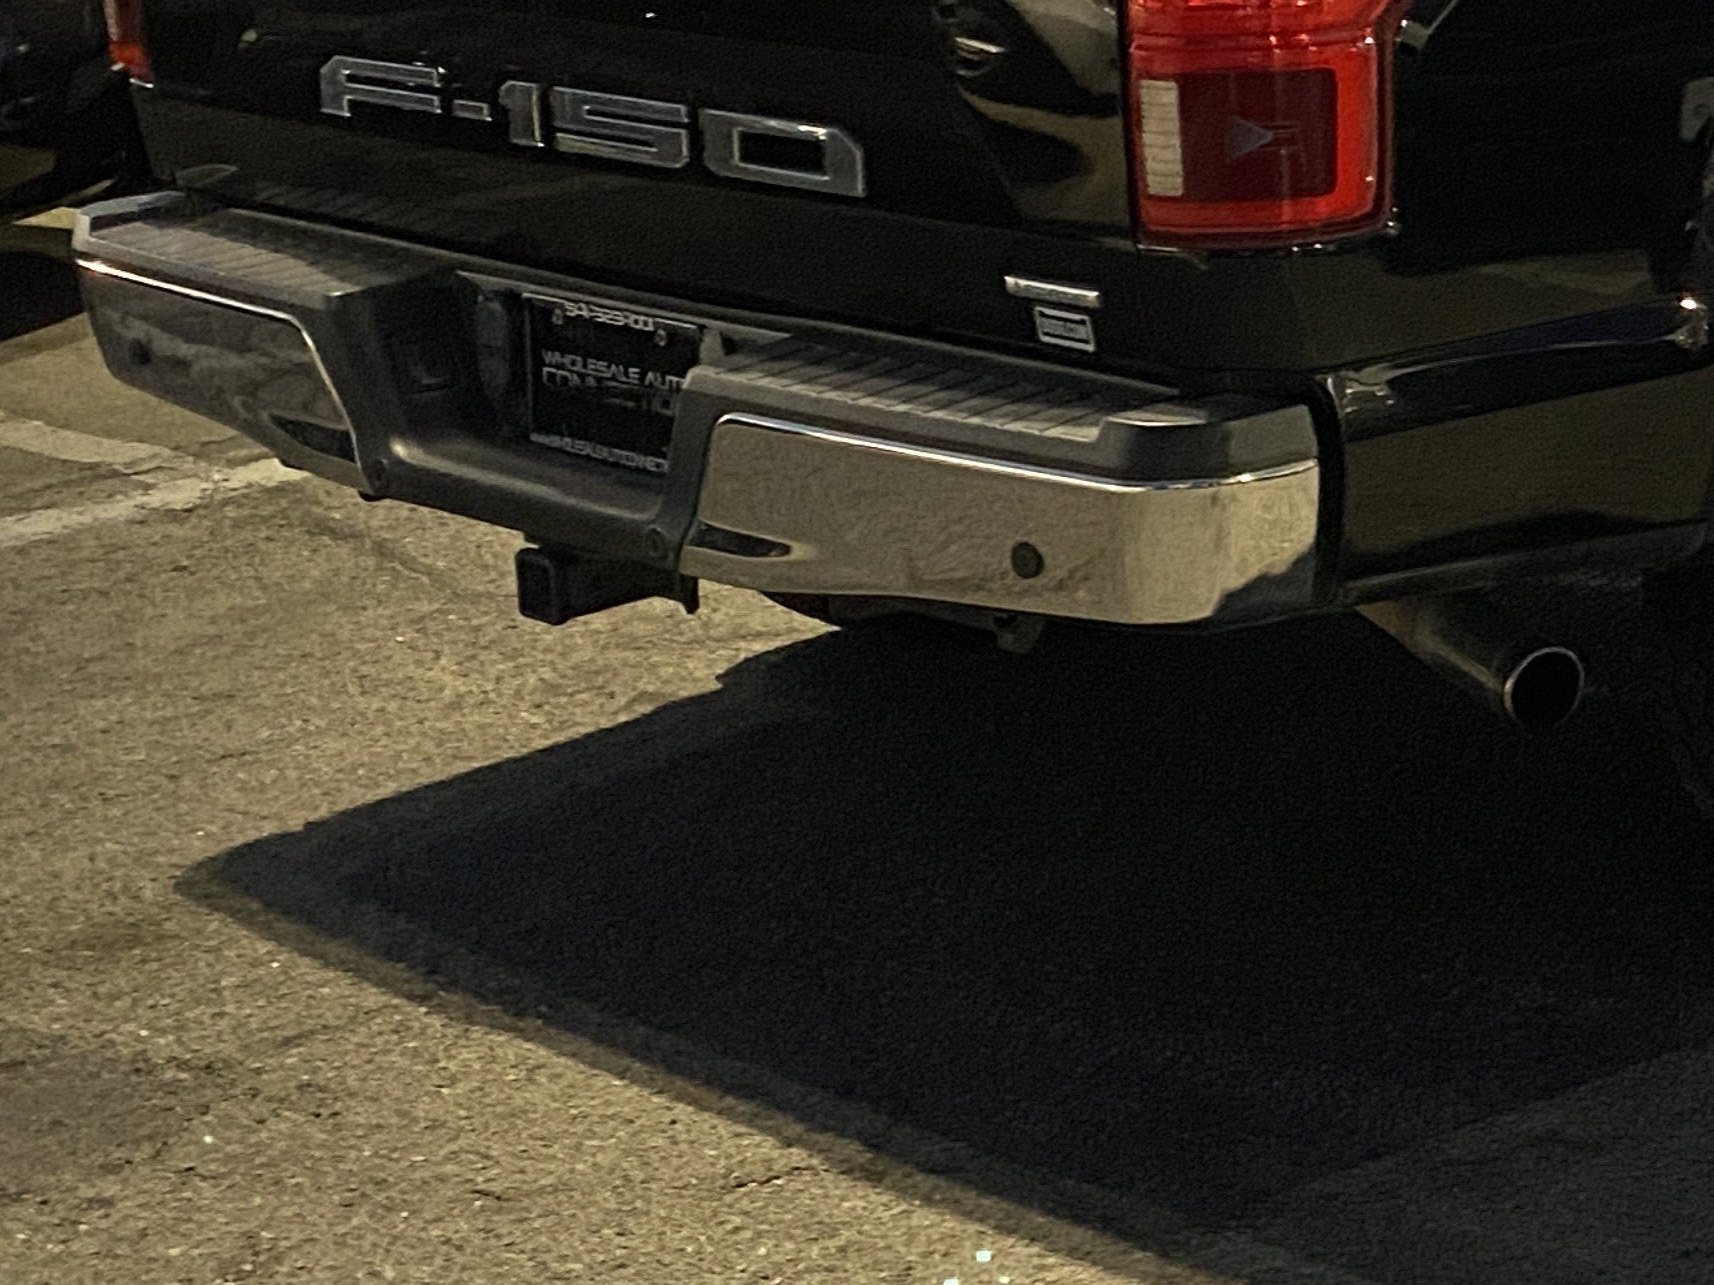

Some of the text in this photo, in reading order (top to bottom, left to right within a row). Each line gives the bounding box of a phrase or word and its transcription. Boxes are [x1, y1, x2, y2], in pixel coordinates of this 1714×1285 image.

[319, 54, 866, 198] F-150
[541, 350, 641, 385] WHOLESALE
[645, 371, 684, 391] AUT
